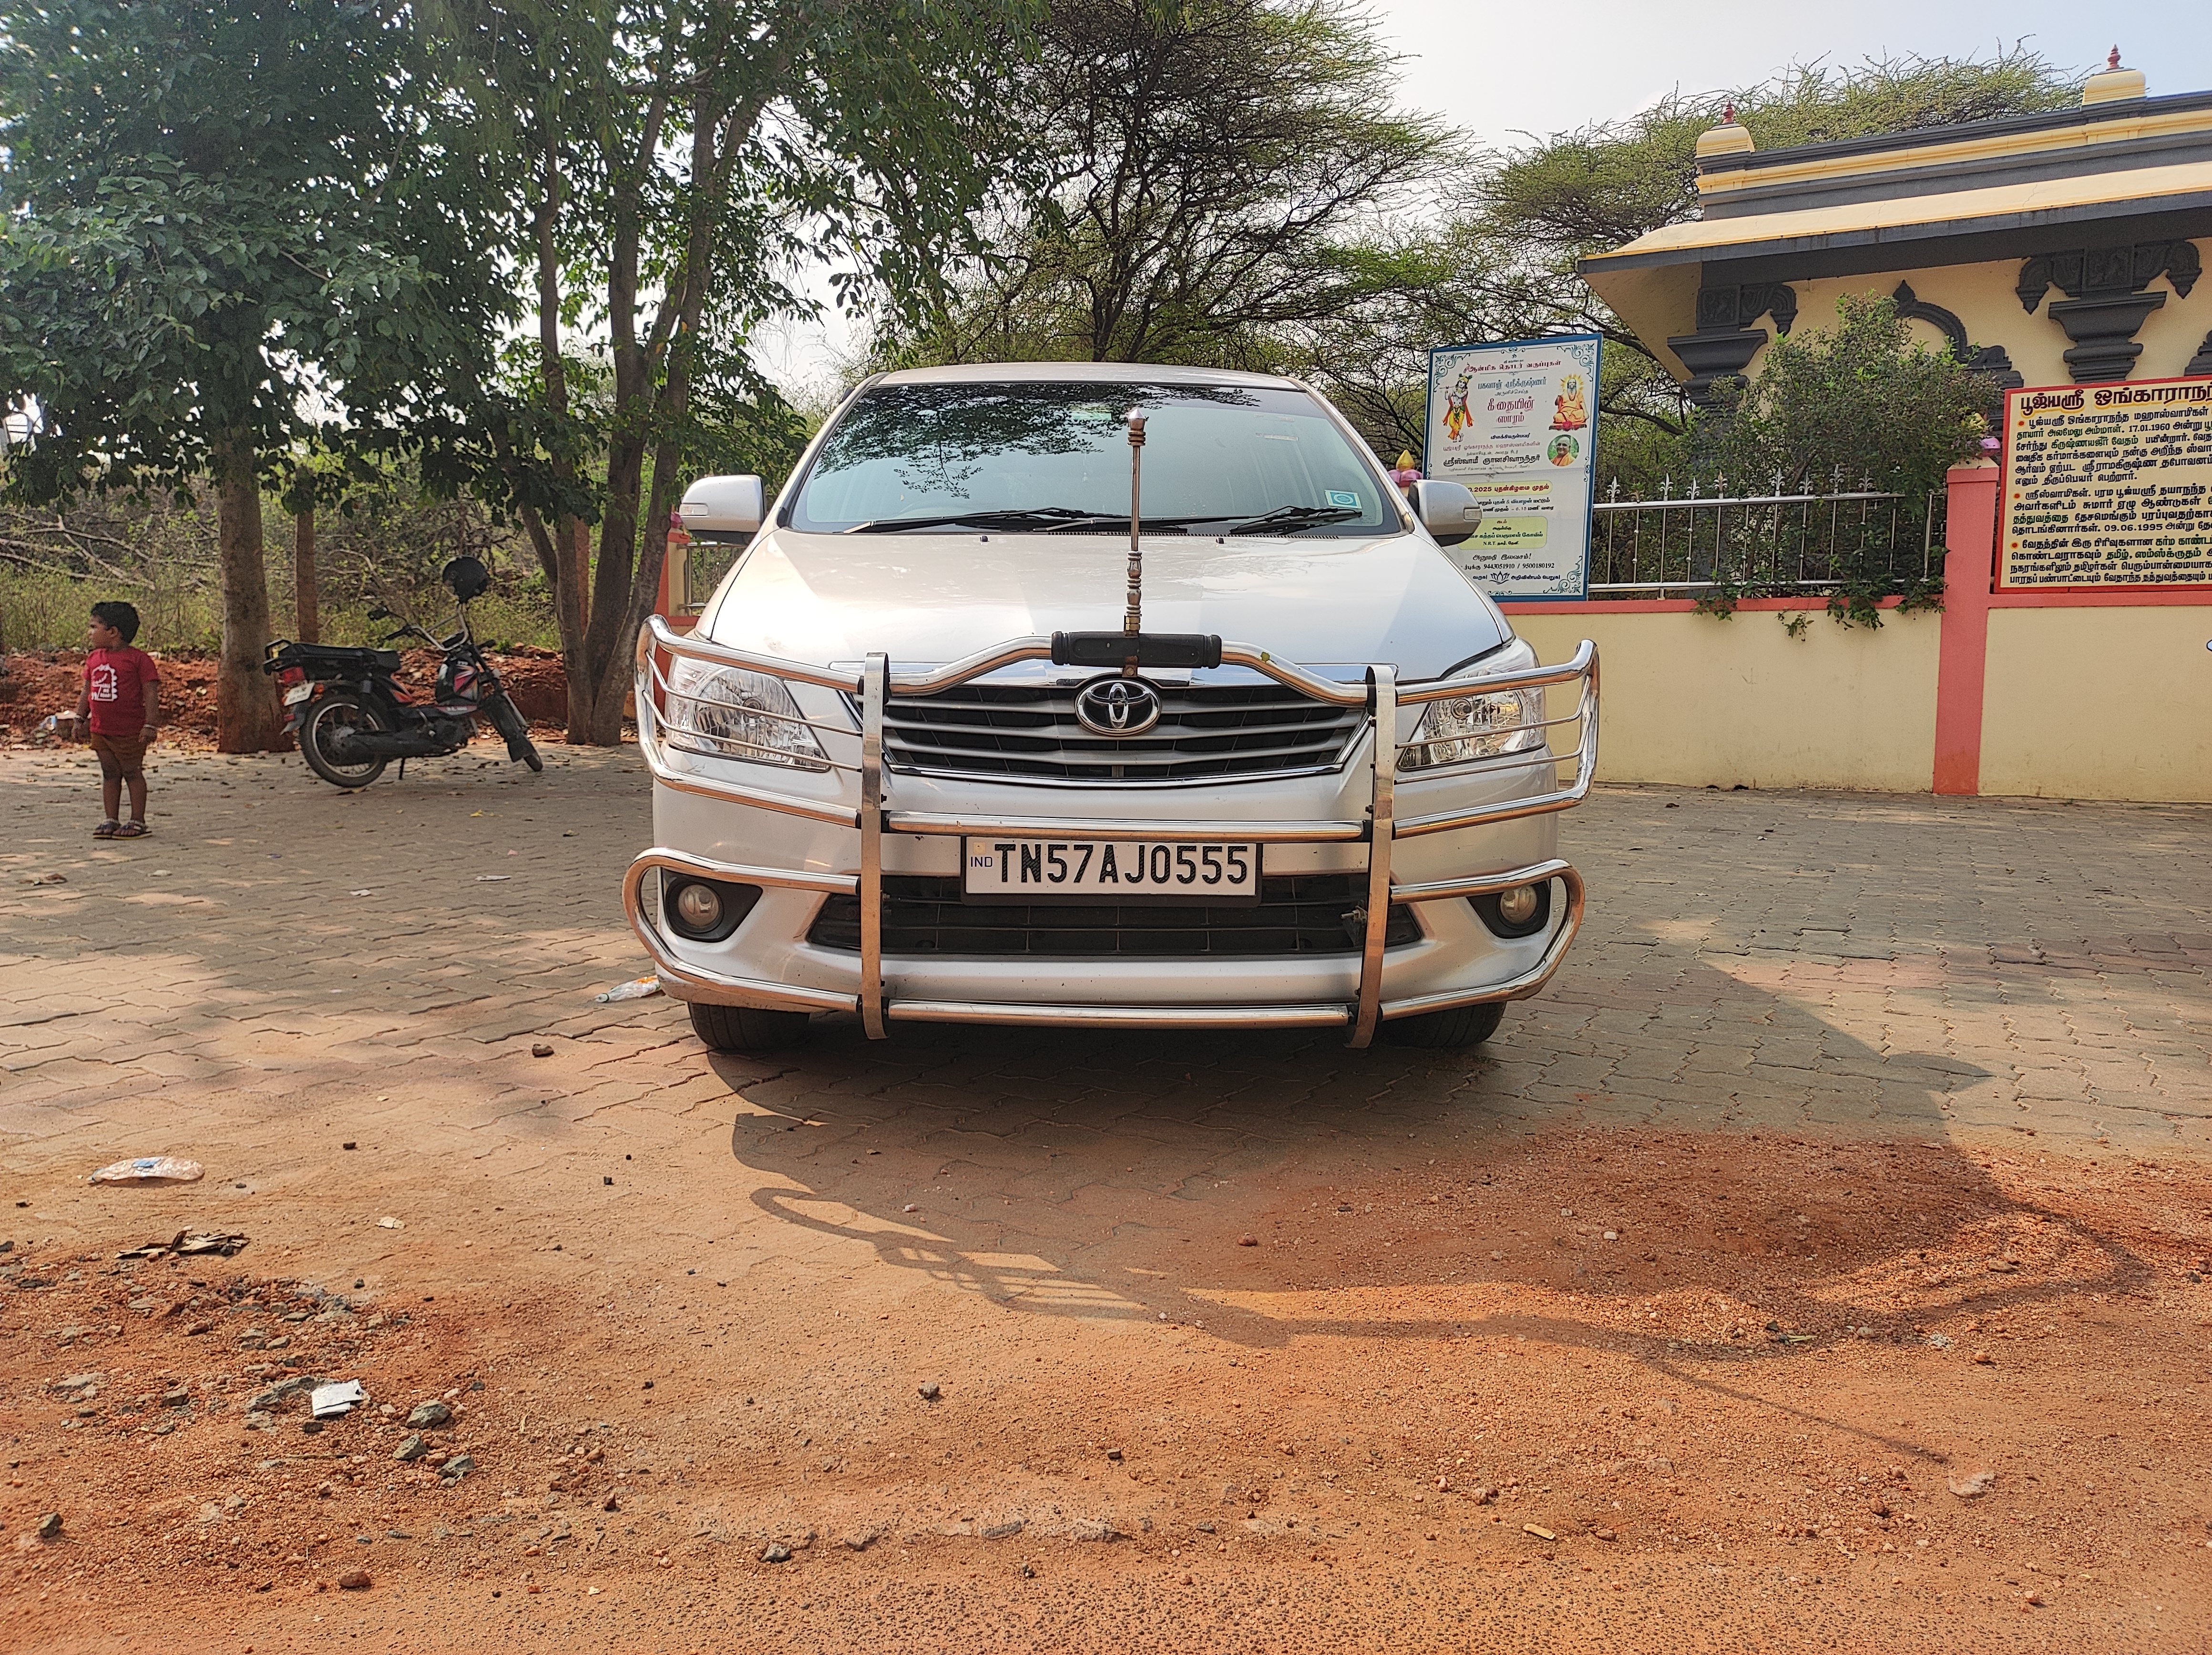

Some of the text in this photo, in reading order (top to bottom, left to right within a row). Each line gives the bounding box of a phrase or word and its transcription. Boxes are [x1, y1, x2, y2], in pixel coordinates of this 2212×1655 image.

[1526, 360, 1561, 368] வகுப்புகள்
[1487, 396, 1535, 413] கீதையின்
[2021, 389, 2084, 416] பூஜ்யஸ்ரீ
[2029, 415, 2065, 429] பூஜ்யஸ்ரீ
[2068, 411, 2129, 425] ஓங்காராநந்த
[2134, 406, 2208, 422] மஹாஸ்வாமிகள்
[2017, 428, 2044, 441] தாயார்
[2048, 428, 2082, 437] அலமேலு
[2085, 424, 2124, 435] அம்மாள்.
[2129, 423, 2170, 432] 17.01.1960
[2173, 419, 2202, 431] அன்று
[2017, 440, 2047, 452] சேர்ந்து
[2111, 435, 2139, 446] வேதம்
[2146, 432, 2190, 444] பயின்றார்.
[1483, 455, 1540, 465] ஞானசிவாநந்தர்
[2016, 452, 2043, 462] வைதீக
[2046, 448, 2119, 460] கர்மாக்களையும்
[2121, 446, 2148, 458] நன்கு
[2151, 444, 2182, 457] அறிந்த
[2015, 462, 2046, 475] ஆர்வம்
[2049, 461, 2076, 474] ஏற்பட
[2015, 470, 2137, 487] எனும் திருப்பெயர் பெற்றார்.
[2095, 489, 2113, 498] பரம
[2116, 484, 2156, 499] பூஜ்யஸ்ரீ
[2158, 483, 2206, 496] தயாநந்த
[2014, 500, 2076, 511] அவர்களிடம்
[2083, 499, 2113, 509] சுமார்
[2116, 500, 2136, 511] ஏழு
[2141, 496, 2201, 509] ஆண்டுகள்
[2013, 512, 2069, 525] தத்துவத்தை
[2075, 510, 2137, 522] தேசமெங்கும்
[2012, 523, 2100, 536] தொடங்கினார்கள்.
[2104, 523, 2163, 531] 09.06.1995
[2165, 521, 2194, 531] அன்று
[2022, 538, 2069, 550] வேதத்தின்
[2071, 538, 2091, 548] இரு
[2094, 538, 2153, 548] பிரிவுகளான
[2155, 535, 2175, 546] கர்ம
[2011, 549, 2101, 562] கொண்டவராகவும்
[2105, 549, 2132, 560] தமிழ்,
[2135, 547, 2202, 560] ஸம்ஸ்க்ருதம்
[2010, 561, 2071, 574] நகரங்களிலும்
[2072, 561, 2117, 573] தமிழர்கள்
[2010, 573, 2037, 584] பாரதப்
[2039, 572, 2100, 583] பண்பாட்டையும்
[2104, 572, 2140, 583] வேதாந்த
[2142, 571, 2206, 583] தத்துவத்தையும்
[971, 856, 993, 868] IND
[994, 844, 1248, 884] TN57AJ0555
